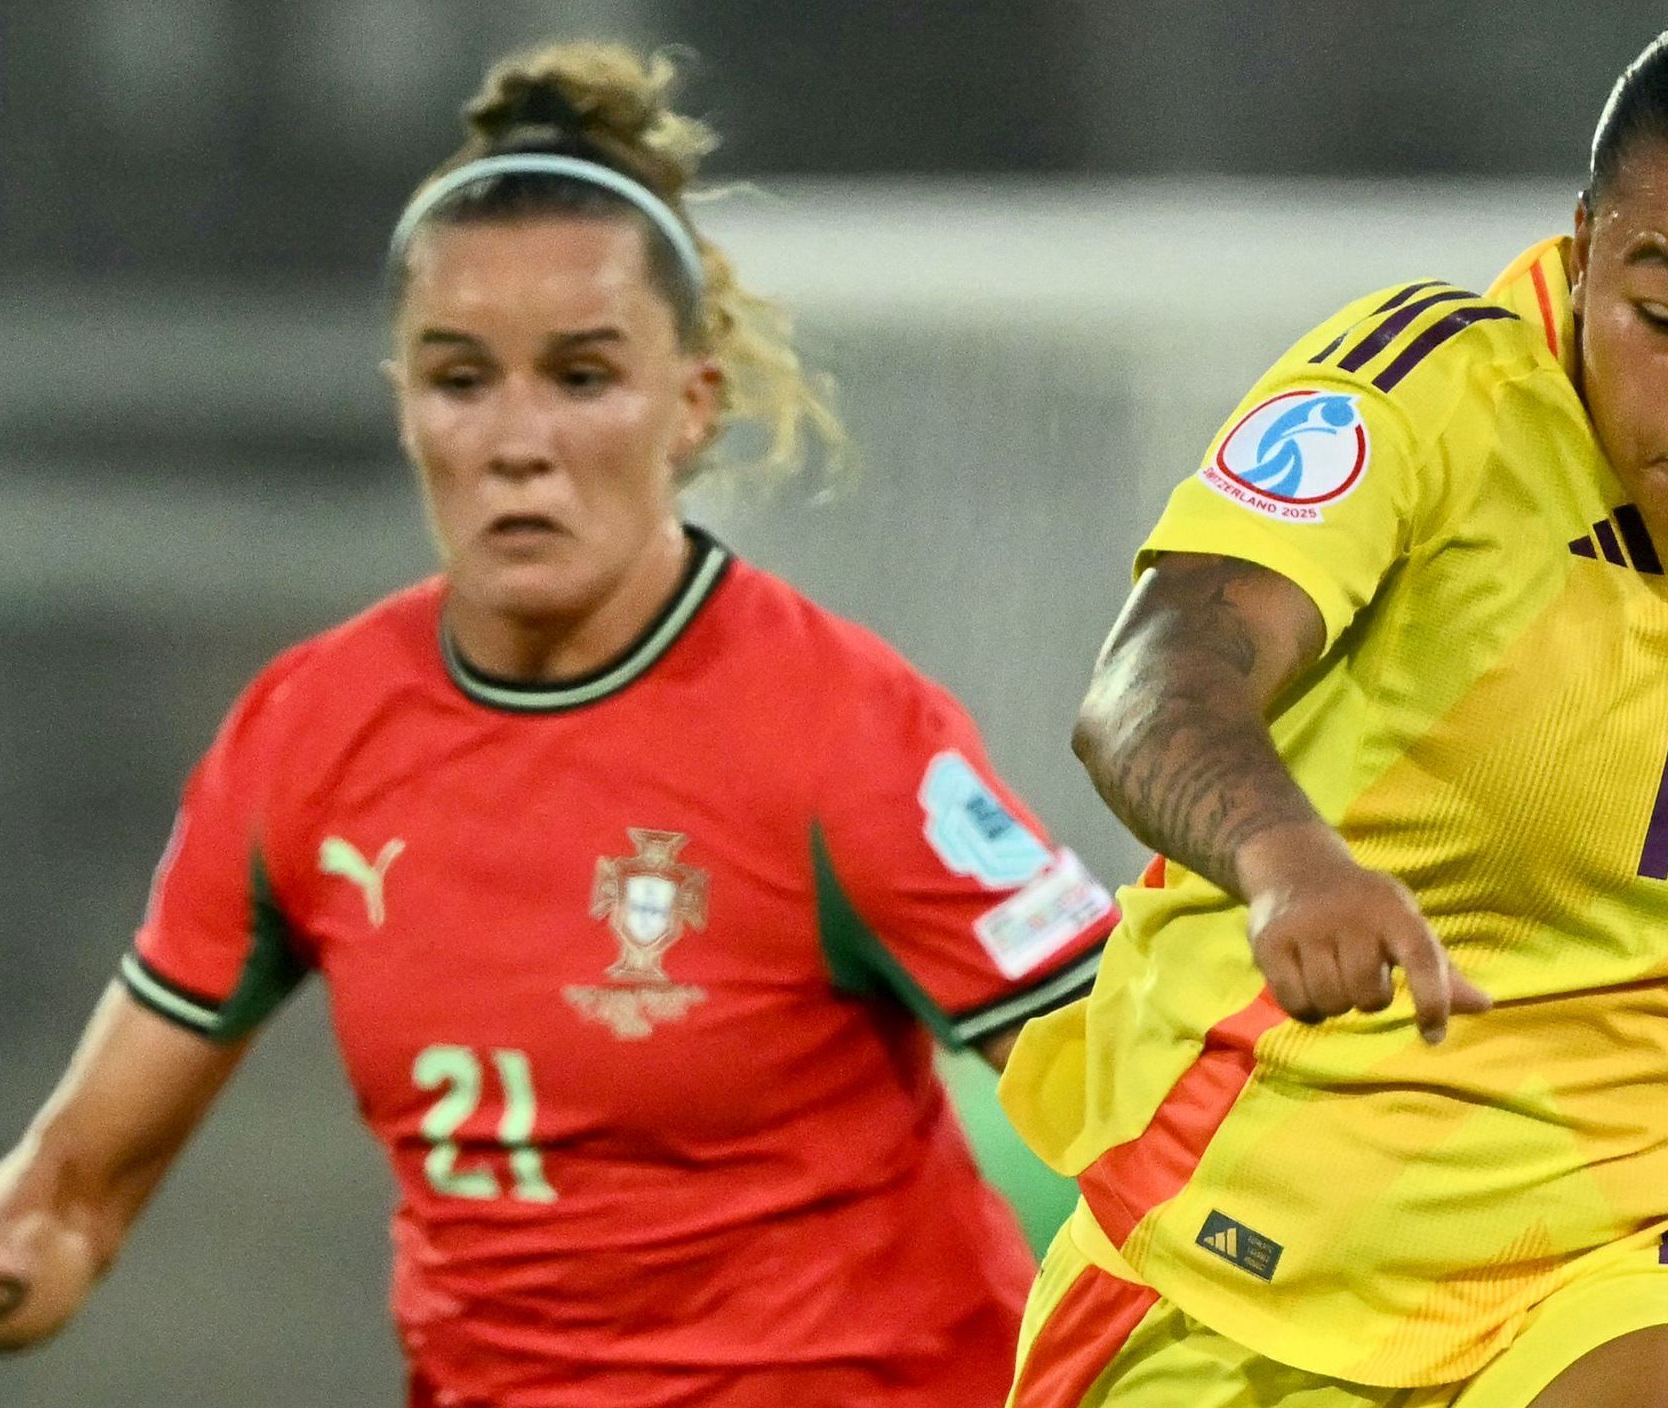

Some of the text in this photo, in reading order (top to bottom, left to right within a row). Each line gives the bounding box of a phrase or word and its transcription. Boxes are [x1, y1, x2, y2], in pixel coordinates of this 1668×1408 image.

[1203, 467, 1317, 519] SWITZERLAND 2025
[412, 1044, 558, 1204] 21
